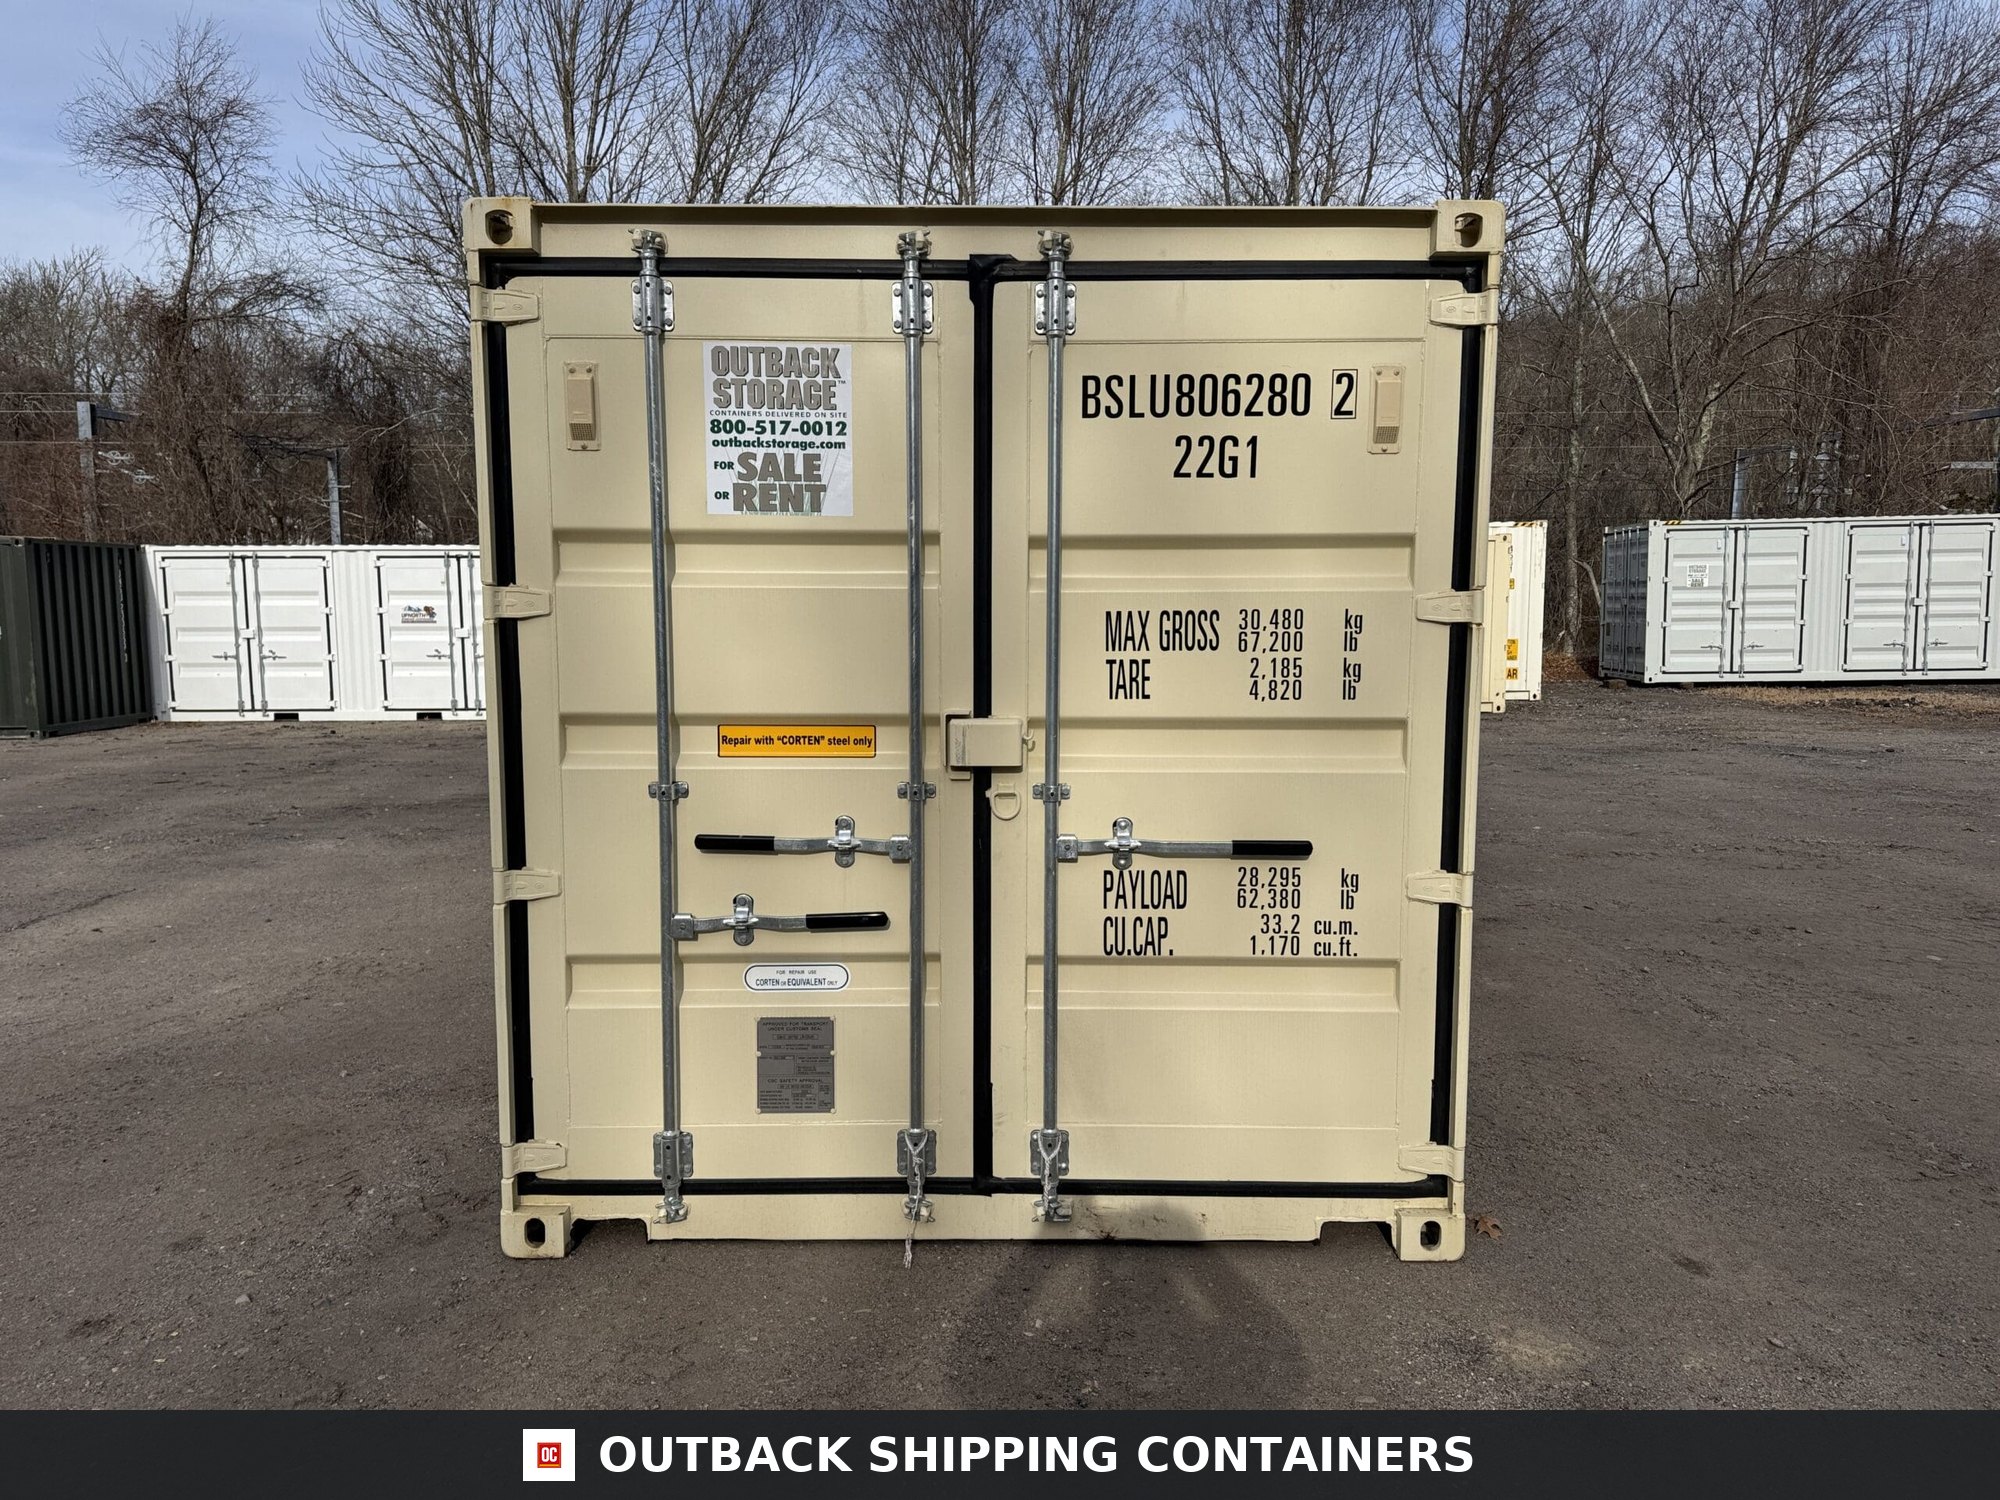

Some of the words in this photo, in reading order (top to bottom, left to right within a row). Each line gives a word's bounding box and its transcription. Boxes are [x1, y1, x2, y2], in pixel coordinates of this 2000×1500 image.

[711, 346, 841, 378] OUTBACK
[712, 378, 837, 410] STORAGE
[1082, 373, 1311, 418] BSLU806280
[1334, 373, 1354, 416] 2
[710, 419, 848, 436] 800-517-0012
[712, 436, 846, 451] outbackstorage.com
[714, 461, 735, 470] FOR
[737, 452, 822, 482] SALE
[1173, 435, 1258, 479] 22G1
[714, 491, 730, 500] OR
[733, 482, 827, 512] RENT
[1105, 610, 1150, 651] MAX
[1159, 610, 1219, 651] GROSS
[1239, 609, 1303, 631] 30,480
[1344, 608, 1363, 634] kg
[1238, 631, 1303, 653] 67,200
[1344, 631, 1358, 651] lb
[1106, 659, 1150, 699] TARE
[1250, 657, 1302, 679] 2,185
[1343, 657, 1362, 682] kg
[1249, 680, 1302, 701] 4,820
[1342, 679, 1357, 700] lb
[721, 735, 751, 747] Repair
[755, 735, 774, 745] with
[828, 736, 850, 746] steel
[853, 736, 873, 748] only
[1103, 870, 1187, 909] PAYLOAD
[1237, 867, 1301, 888] 28,295
[1340, 868, 1359, 893] kg
[1237, 888, 1301, 909] 62,380
[1340, 889, 1355, 910] lb
[1103, 916, 1174, 956] CU.CAP.
[1260, 914, 1300, 935] 33.2
[1314, 919, 1358, 935] cu.m.
[1313, 937, 1358, 957] cu.ft.
[755, 978, 780, 986] CORTEN
[787, 978, 826, 986] EQUIVALENT
